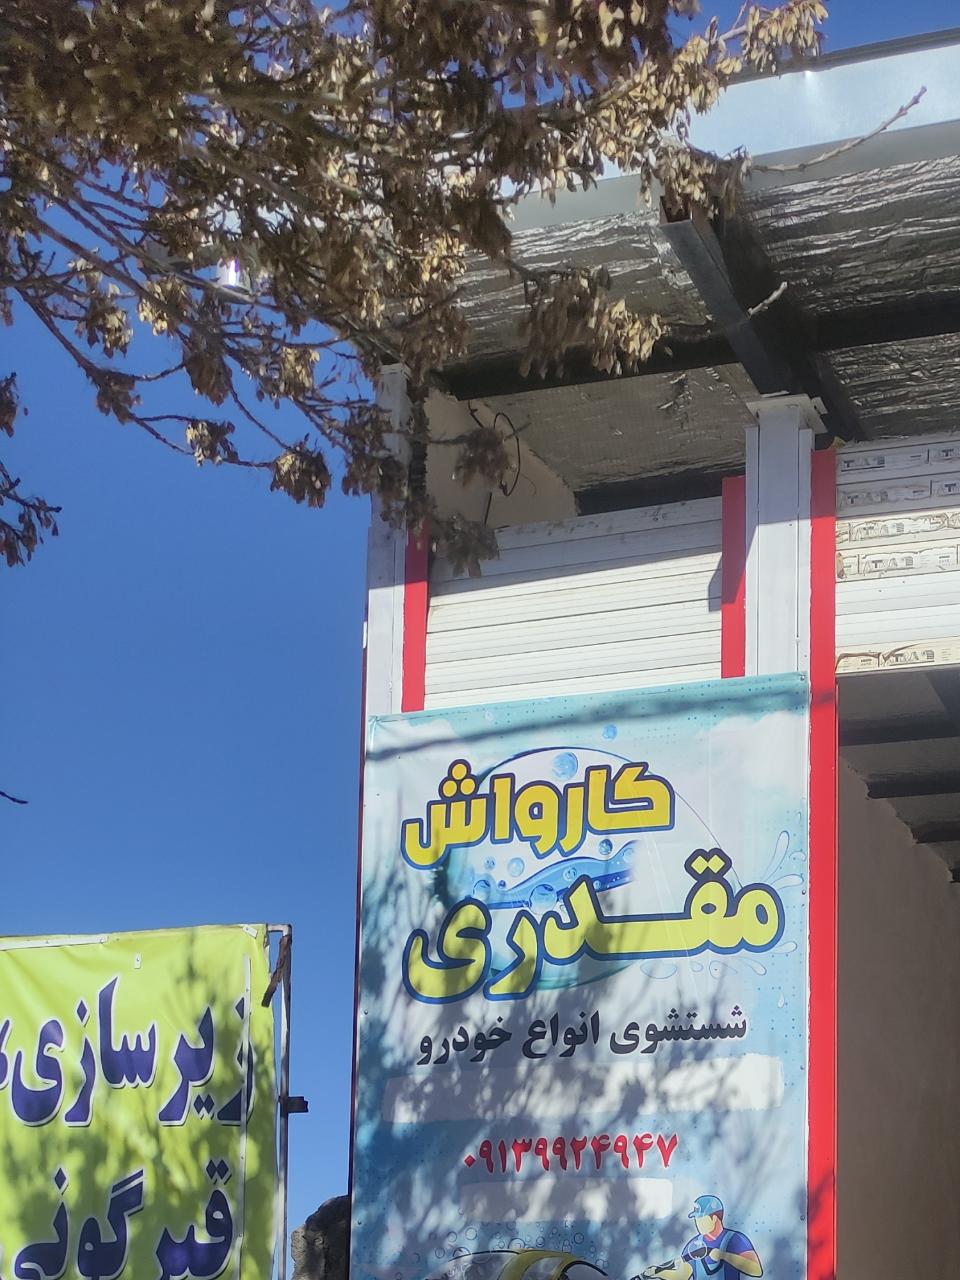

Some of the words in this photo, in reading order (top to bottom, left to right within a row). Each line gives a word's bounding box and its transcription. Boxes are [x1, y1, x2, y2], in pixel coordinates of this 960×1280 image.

[400, 759, 676, 870] کارواش
[402, 848, 786, 1004] مقدری
[416, 1016, 512, 1065] خودرو
[522, 1010, 600, 1059] انواع
[609, 1005, 747, 1055] شستشوی
[463, 1132, 678, 1174] ۰۹۱۳۹۹۲۴۹۴۷
